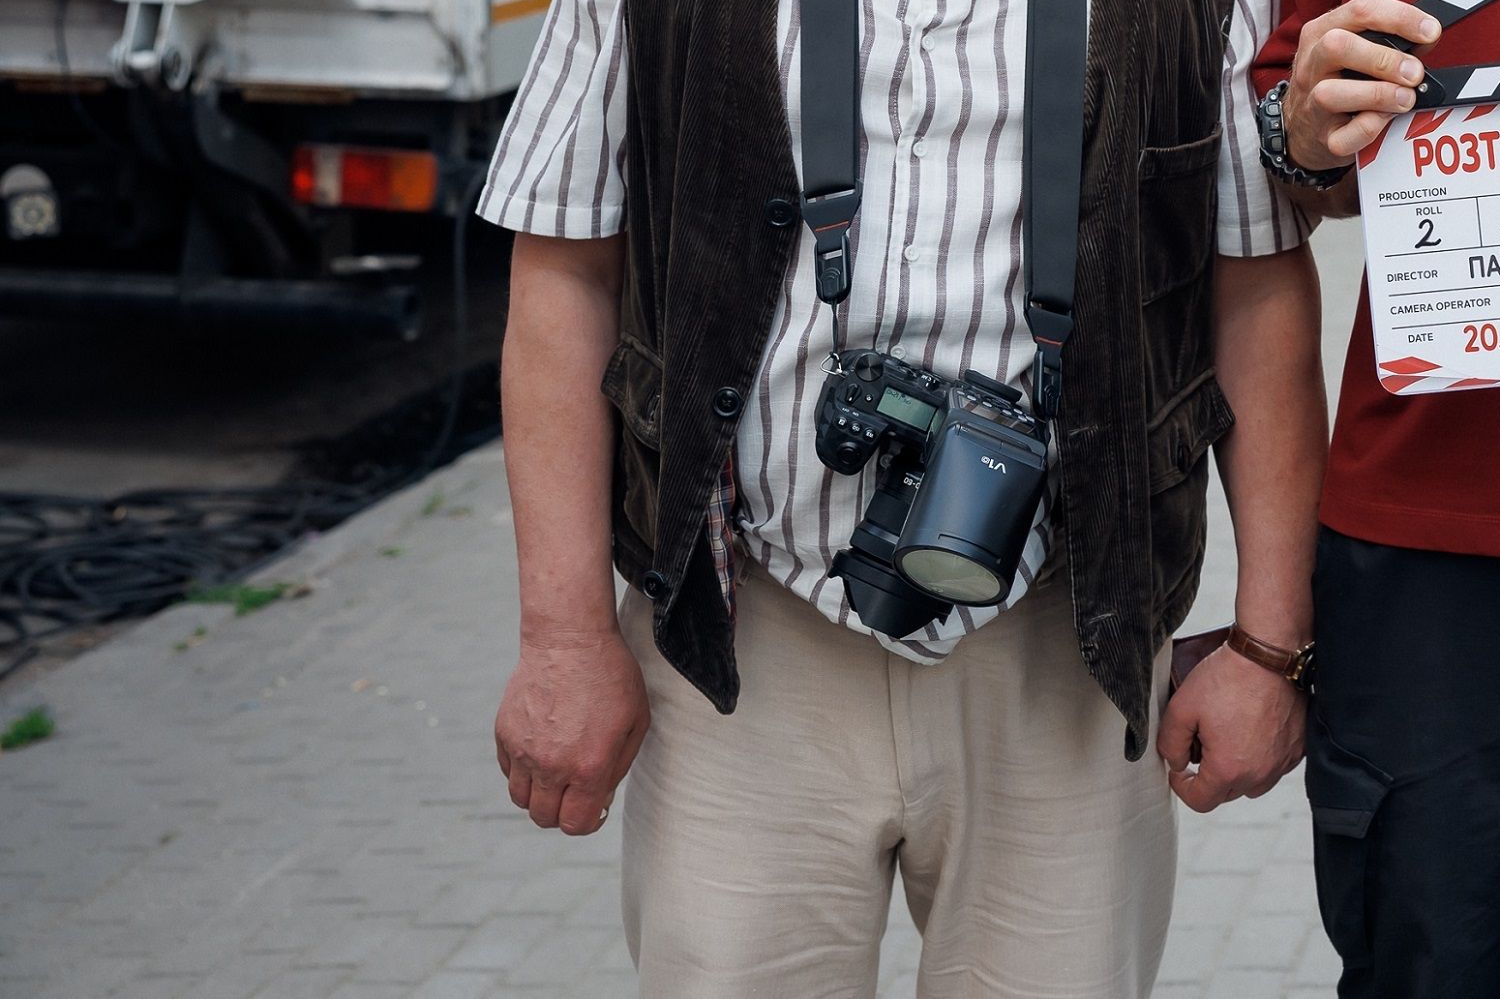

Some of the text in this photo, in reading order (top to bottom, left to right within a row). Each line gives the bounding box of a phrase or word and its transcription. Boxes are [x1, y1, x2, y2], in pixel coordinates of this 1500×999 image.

[1378, 186, 1448, 203] PRODUCTION
[1415, 205, 1443, 217] ROLL
[1413, 218, 1442, 249] 2
[1386, 269, 1439, 283] DIRECTOR
[1390, 297, 1492, 316] CAMERA OPERATOR
[1407, 332, 1434, 344] DATE
